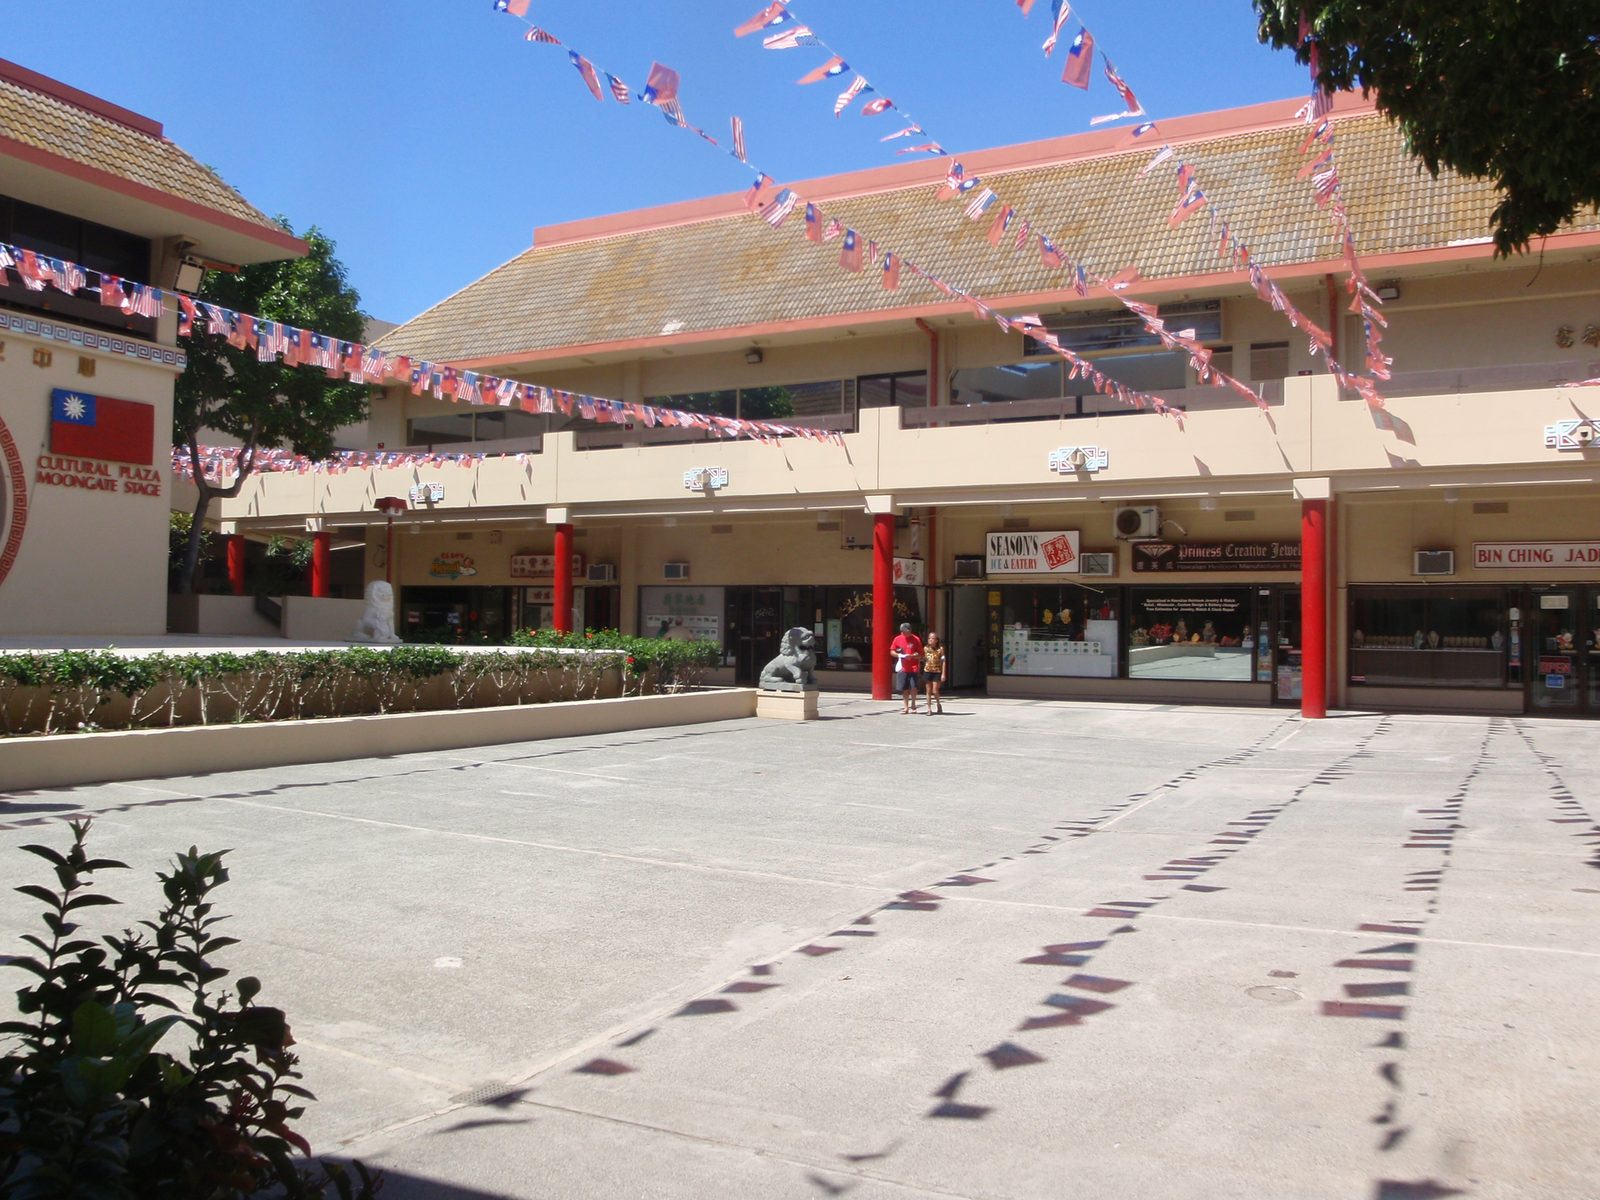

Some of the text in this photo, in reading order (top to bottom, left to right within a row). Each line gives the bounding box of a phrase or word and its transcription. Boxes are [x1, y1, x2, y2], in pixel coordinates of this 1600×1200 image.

[38, 456, 161, 482] CULTURAL PLAZA
[36, 471, 161, 497] MOONGATE STAGE
[990, 535, 1039, 556] SEASON'S
[1178, 544, 1222, 560] Princess
[1225, 543, 1268, 558] Creative
[990, 558, 1038, 570] ICE & EATERY
[1477, 548, 1600, 563] BIN CHING JAD
